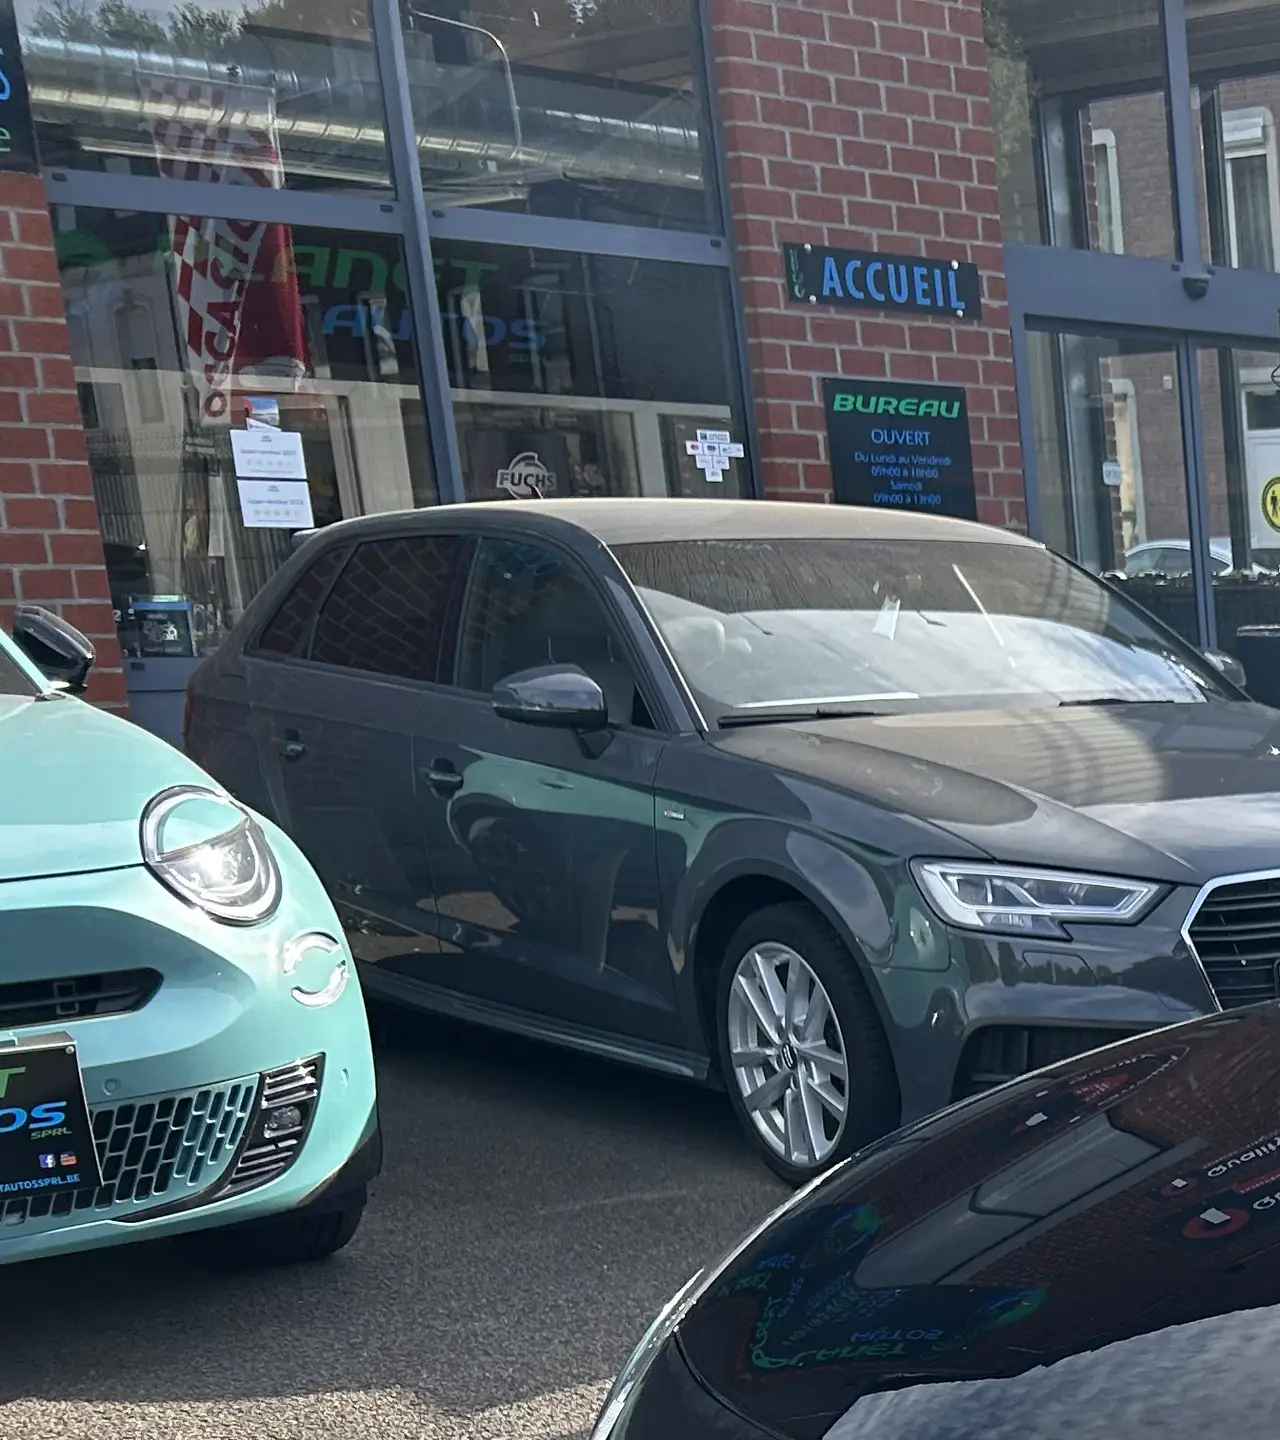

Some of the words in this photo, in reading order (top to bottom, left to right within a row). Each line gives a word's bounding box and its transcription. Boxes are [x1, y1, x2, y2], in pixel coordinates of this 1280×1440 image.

[822, 256, 966, 309] ACCUEIL
[833, 393, 960, 418] BUREAU
[871, 428, 931, 445] OUVERT
[499, 473, 556, 489] FUCHS
[30, 1127, 73, 1140] SPRL
